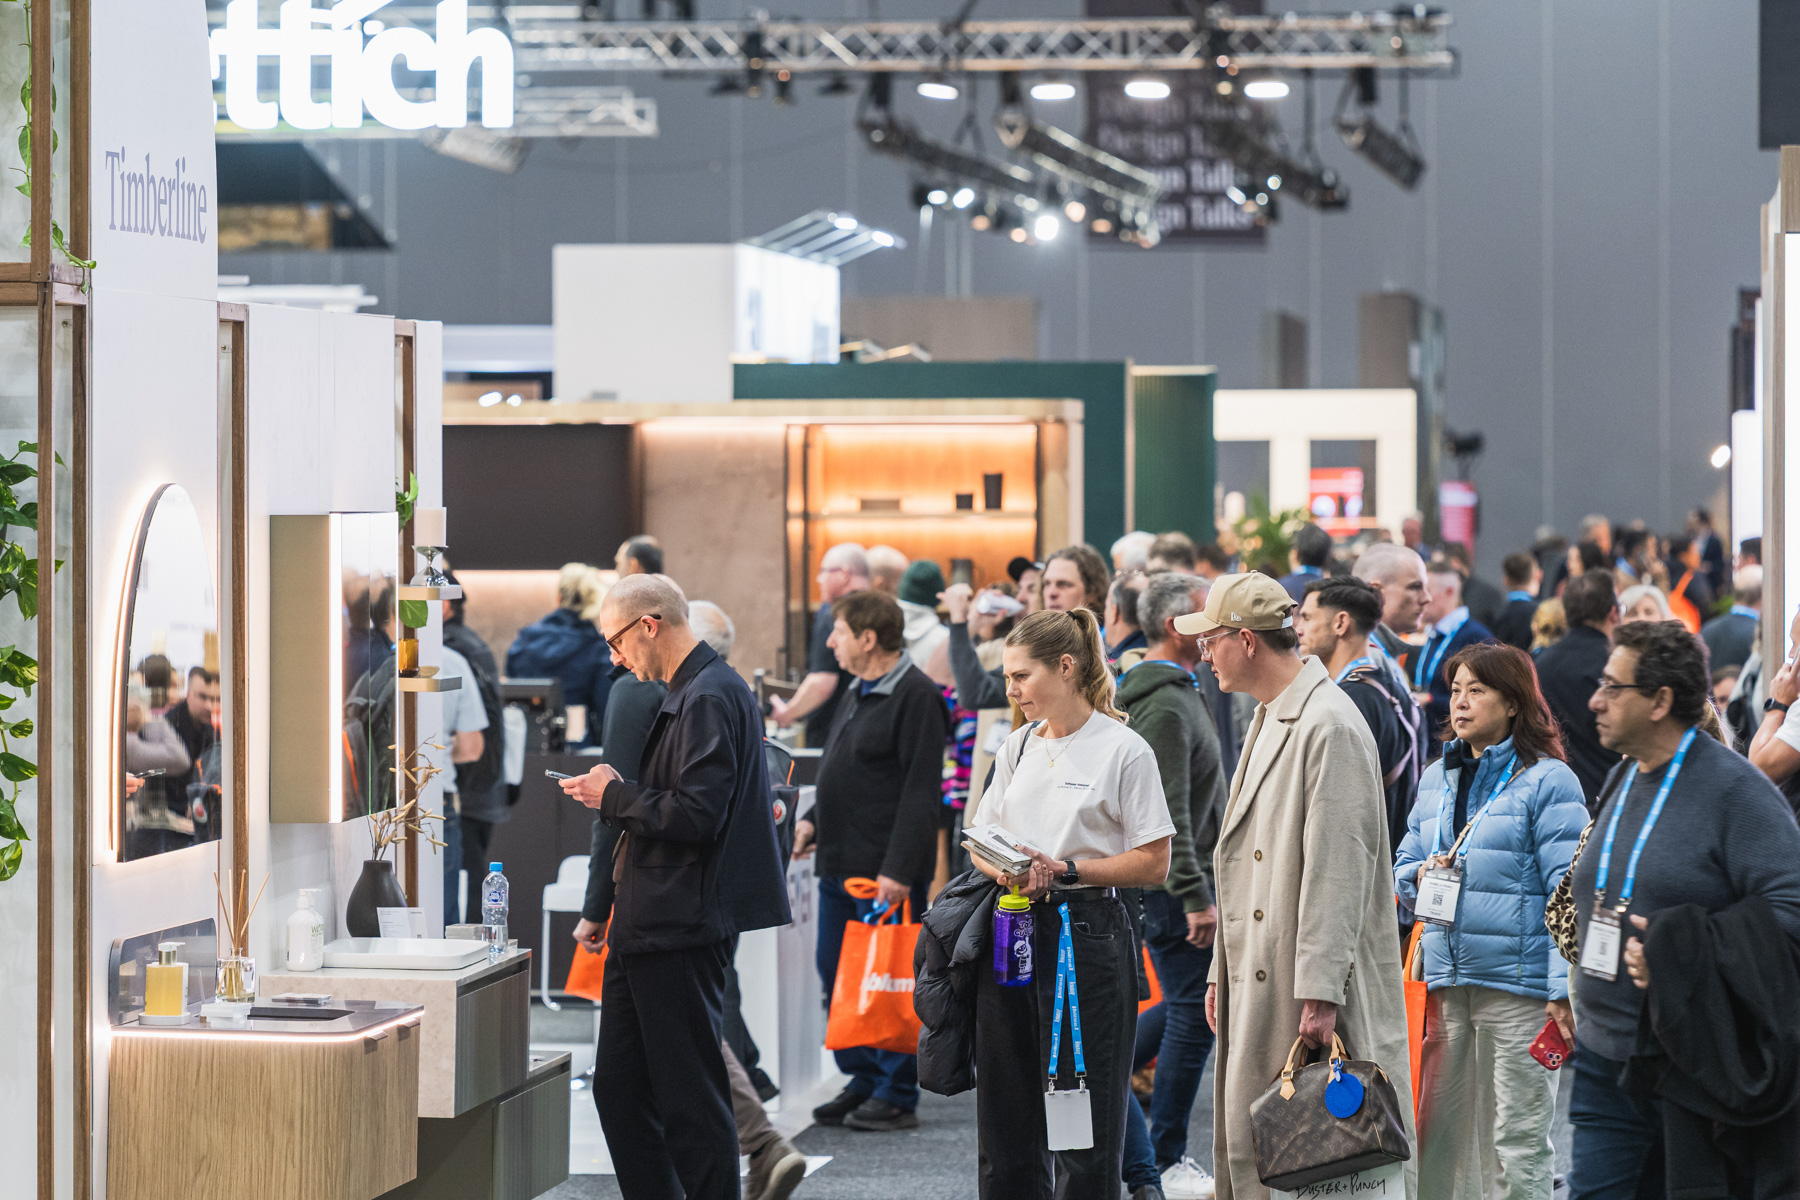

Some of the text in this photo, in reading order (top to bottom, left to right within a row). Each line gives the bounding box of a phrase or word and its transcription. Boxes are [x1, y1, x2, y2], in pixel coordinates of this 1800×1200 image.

[203, 0, 514, 130] ttich
[105, 145, 207, 244] Timberline
[1351, 1172, 1386, 1196] PUNCH
